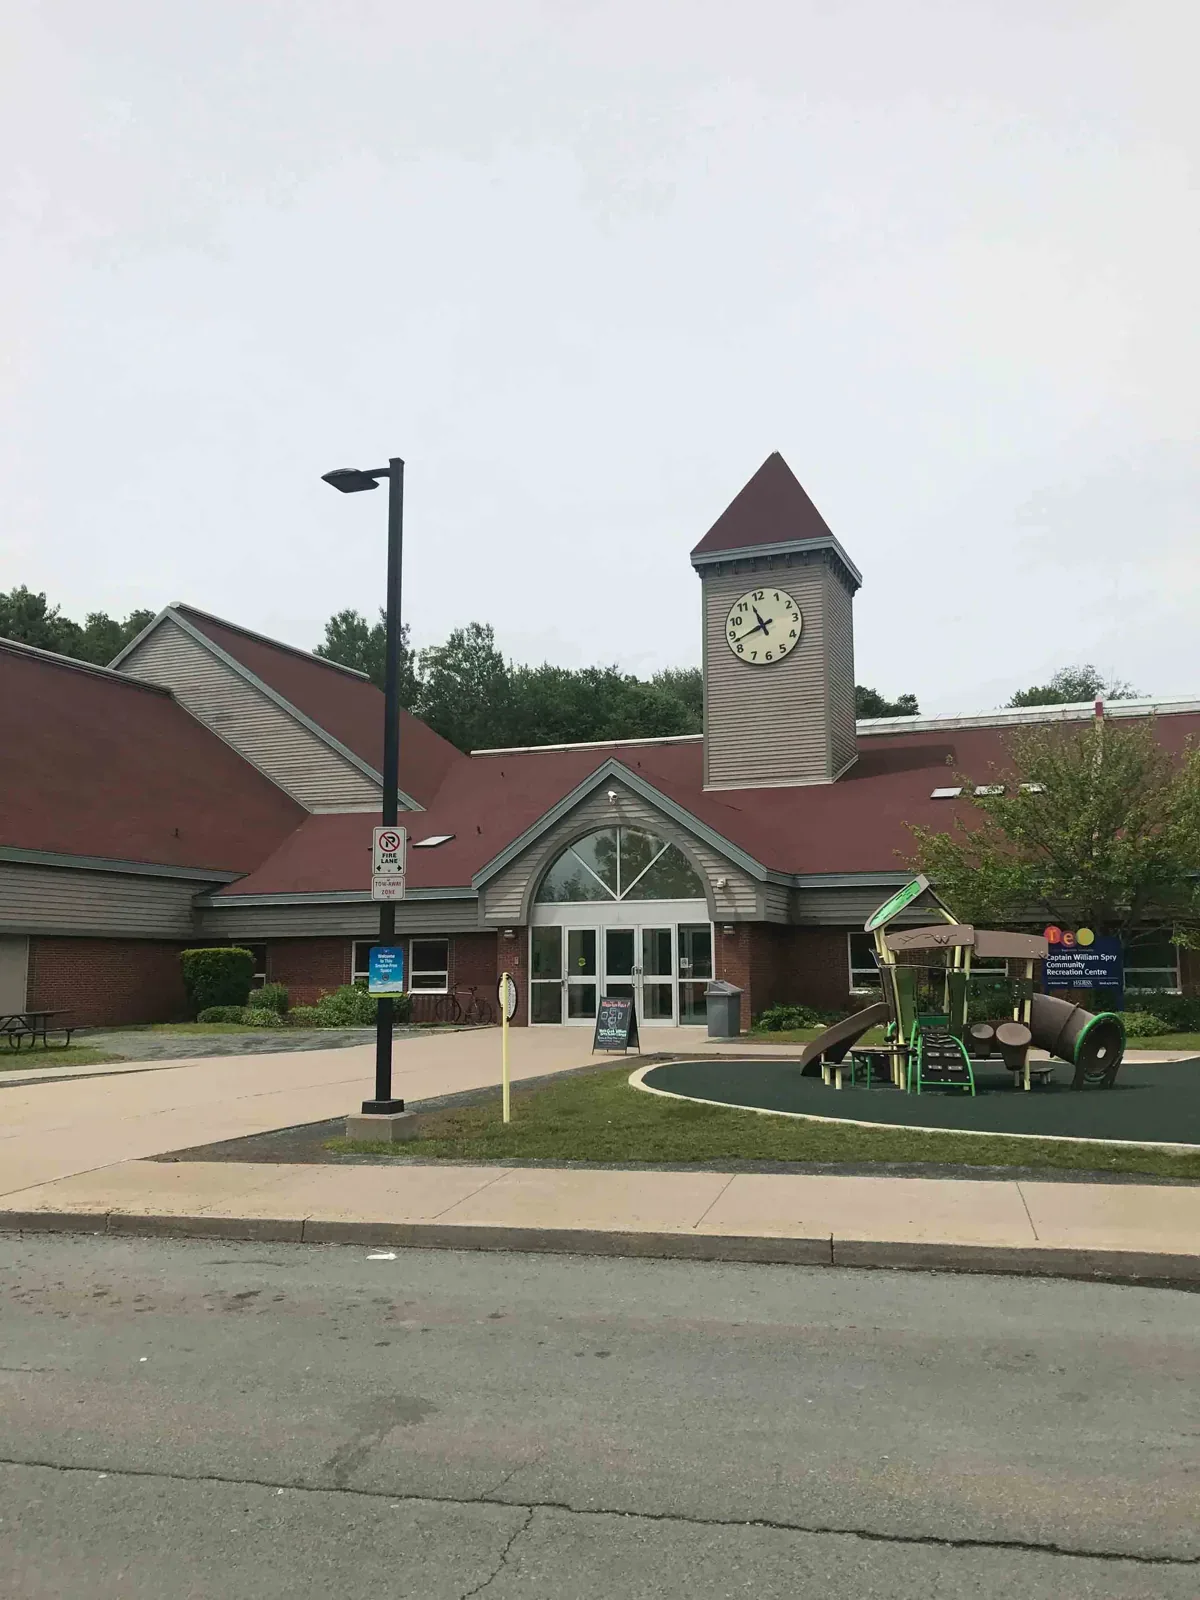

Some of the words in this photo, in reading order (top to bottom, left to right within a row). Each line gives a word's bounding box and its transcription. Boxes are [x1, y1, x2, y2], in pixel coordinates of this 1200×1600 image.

[752, 591, 764, 602] 12
[773, 592, 780, 602] 1
[737, 602, 748, 612] 11
[784, 600, 792, 609] 2
[730, 616, 742, 626] 10
[792, 613, 799, 622] 3
[729, 631, 736, 640] 9
[789, 629, 797, 638] 4
[736, 644, 744, 653] 8
[779, 644, 786, 653] 5
[751, 651, 758, 660] 7
[765, 651, 773, 660] 6
